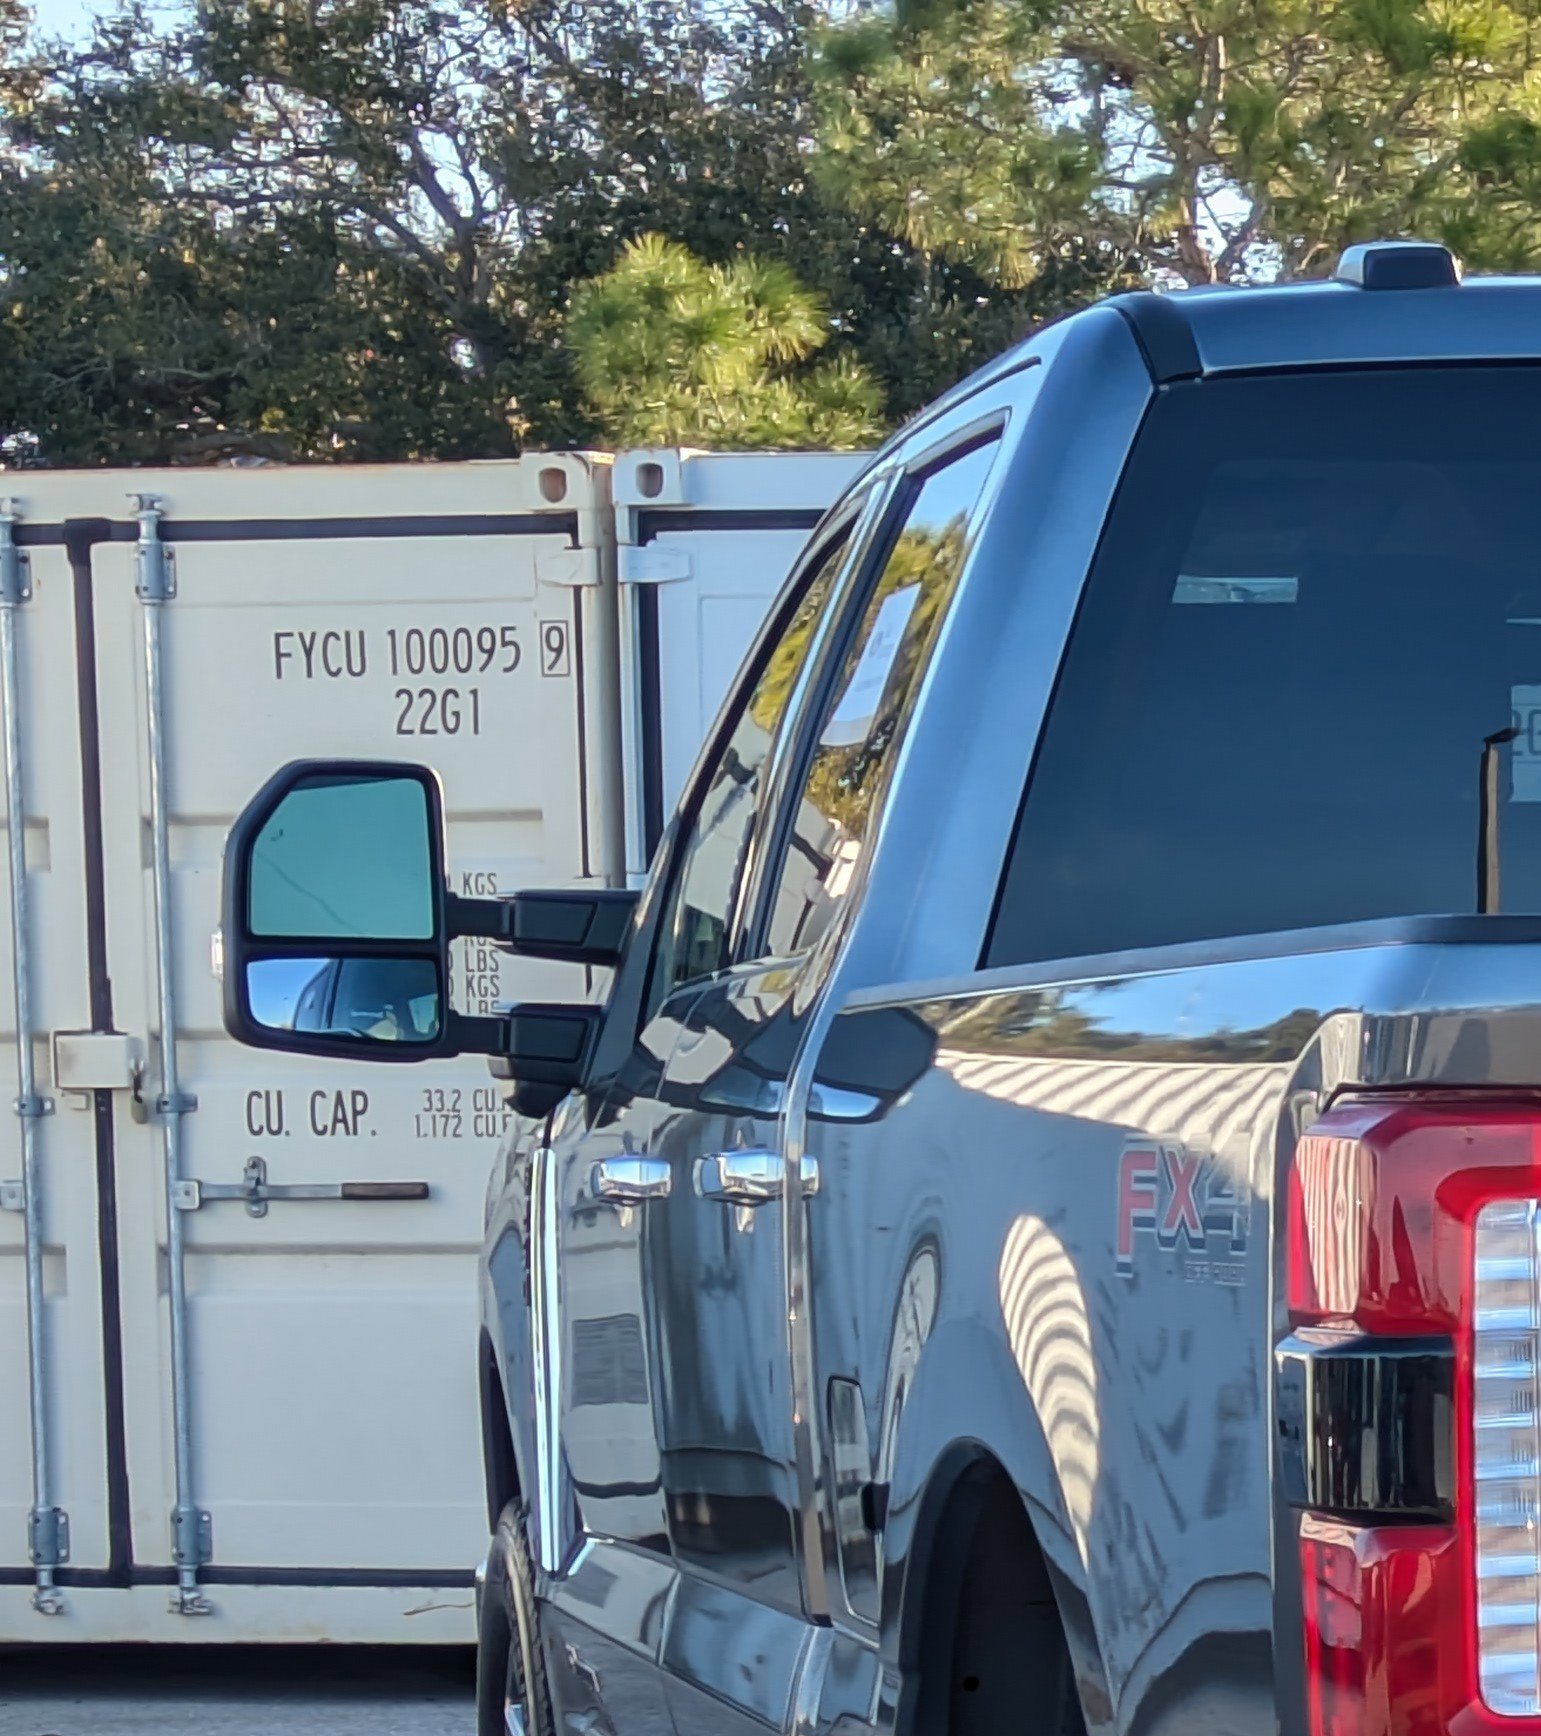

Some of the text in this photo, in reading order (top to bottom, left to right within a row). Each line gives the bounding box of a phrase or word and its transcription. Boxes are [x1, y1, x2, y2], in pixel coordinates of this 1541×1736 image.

[274, 624, 567, 680] FYCU 100095 9
[395, 687, 480, 736] 22G1
[462, 872, 498, 896] KGS
[464, 949, 500, 973] LBS
[465, 975, 501, 998] KGS
[246, 1090, 291, 1137] CU.
[310, 1090, 377, 1137] CAP.
[422, 1088, 462, 1113] 33.2
